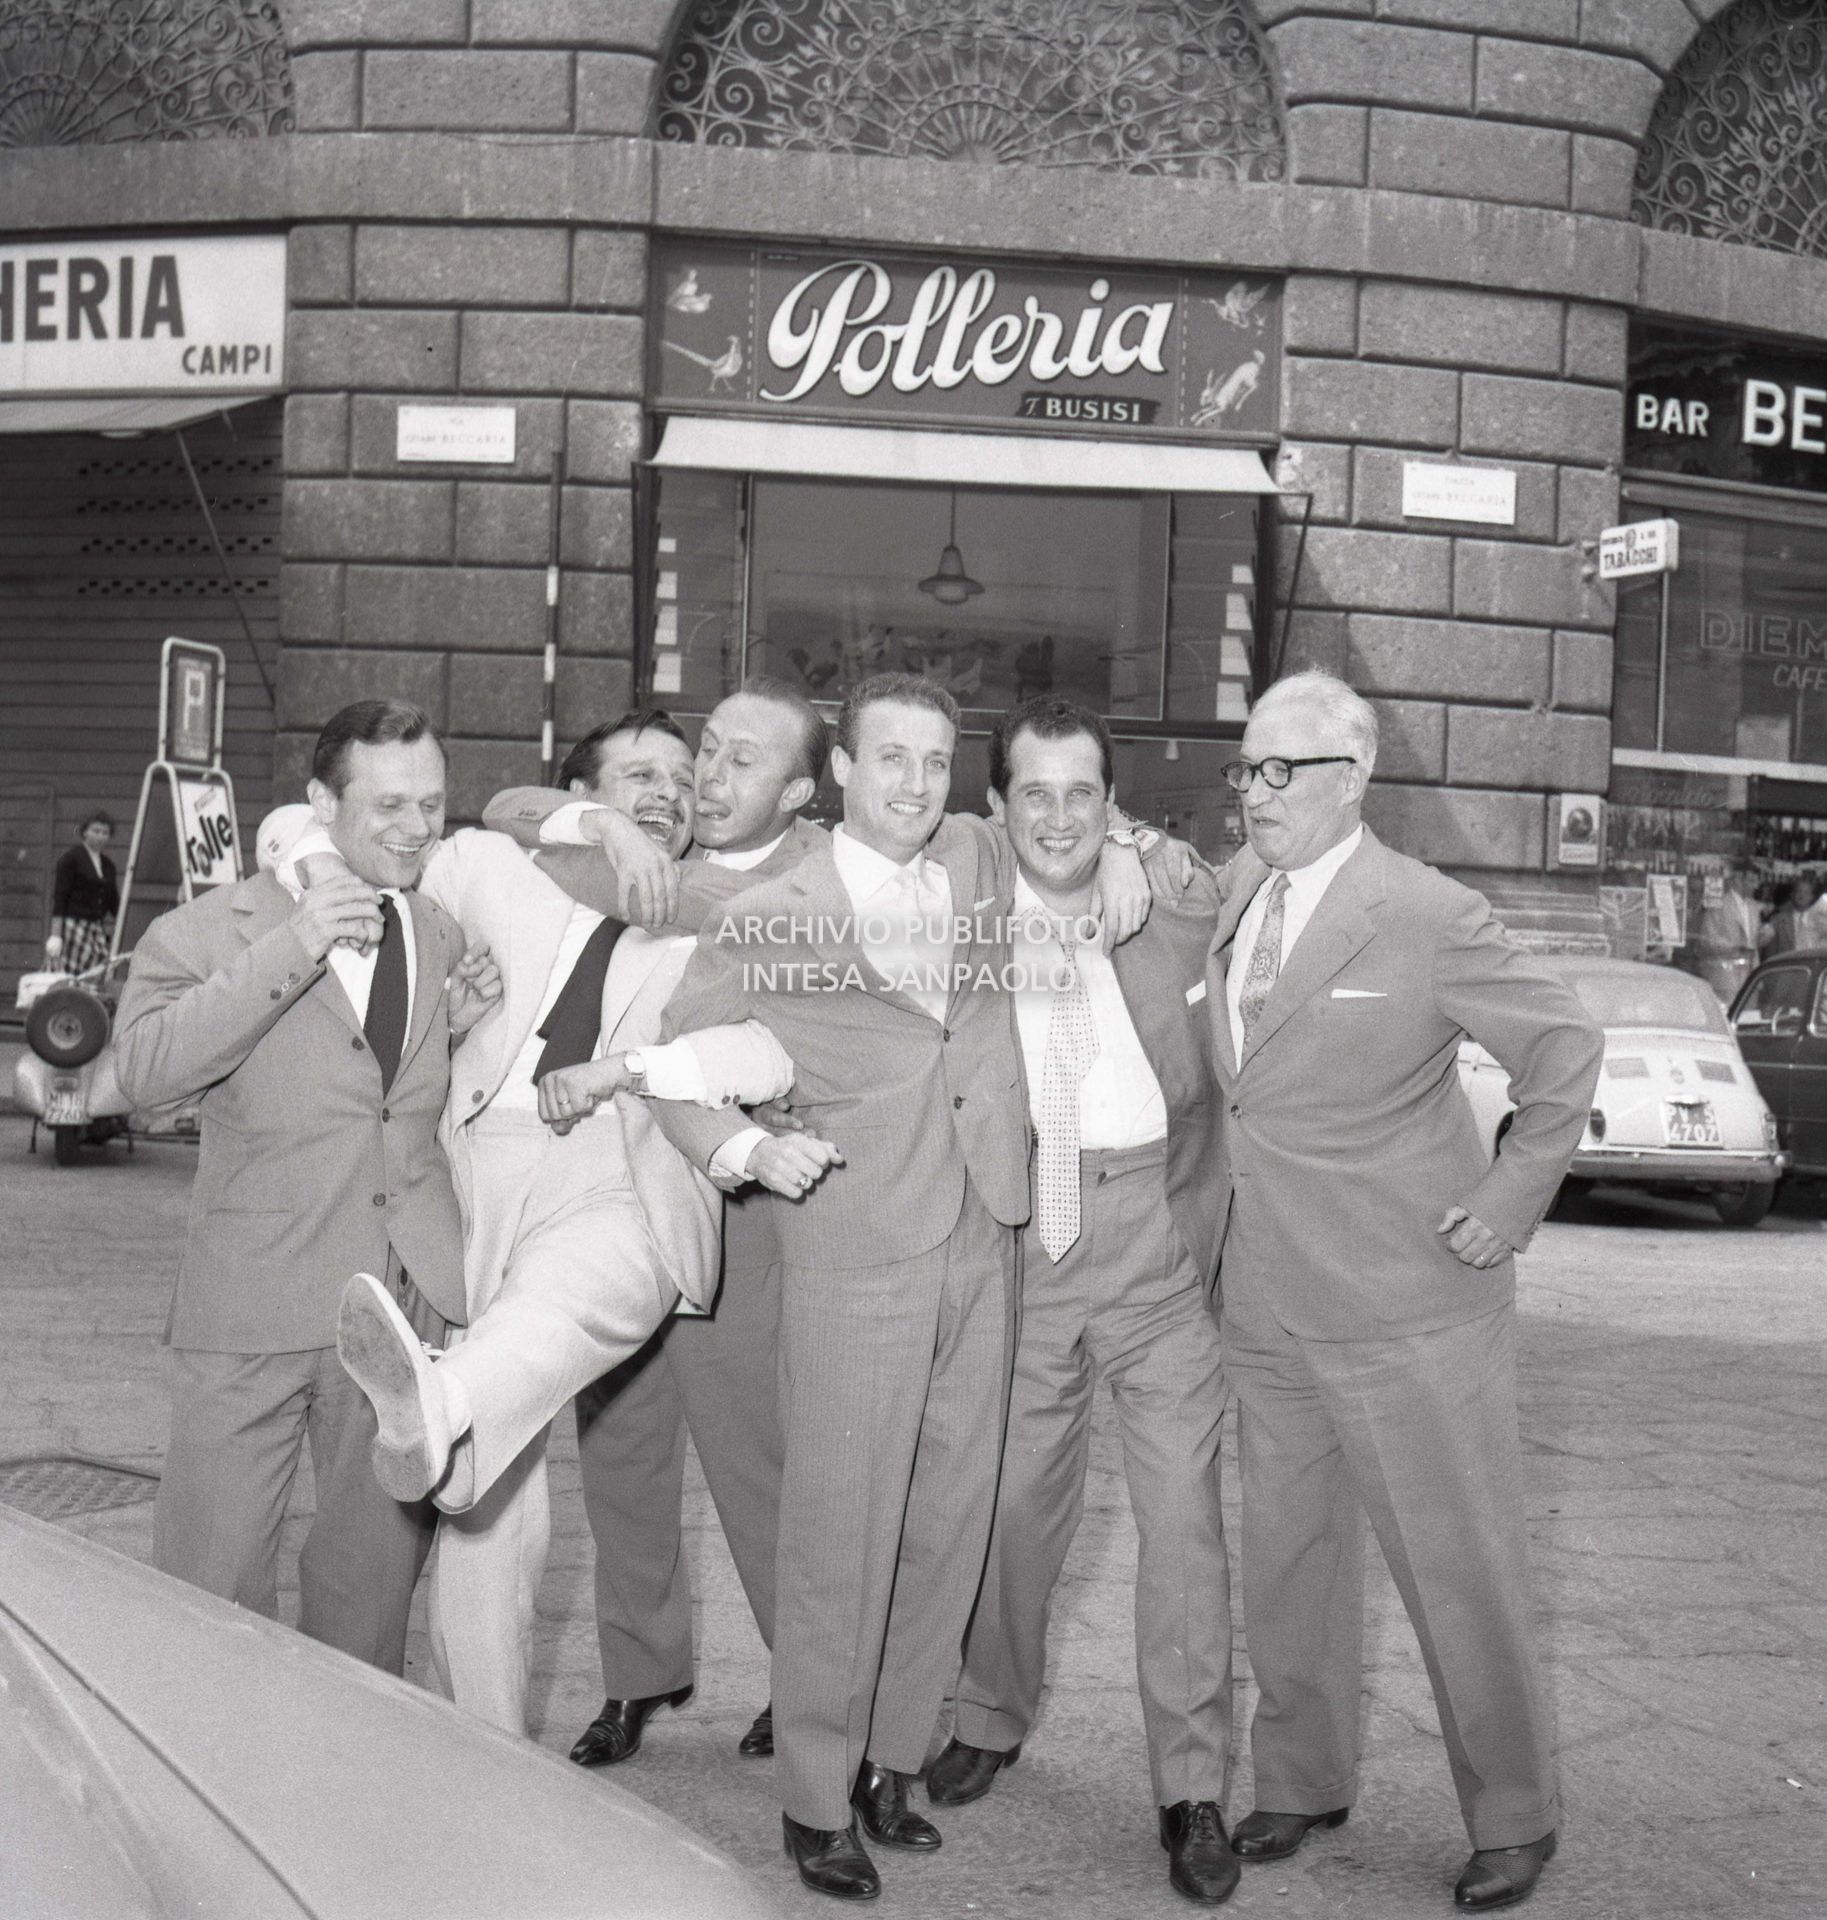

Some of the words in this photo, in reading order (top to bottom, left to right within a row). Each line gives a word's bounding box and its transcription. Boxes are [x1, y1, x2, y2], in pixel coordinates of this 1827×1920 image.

[759, 259, 1174, 402] Polleria
[181, 344, 272, 375] CAMPI
[1045, 396, 1141, 423] BUSISI
[1636, 393, 1710, 438] BAR
[1742, 377, 1827, 455] BE
[1603, 545, 1659, 571] TABACCHI
[182, 670, 206, 732] P
